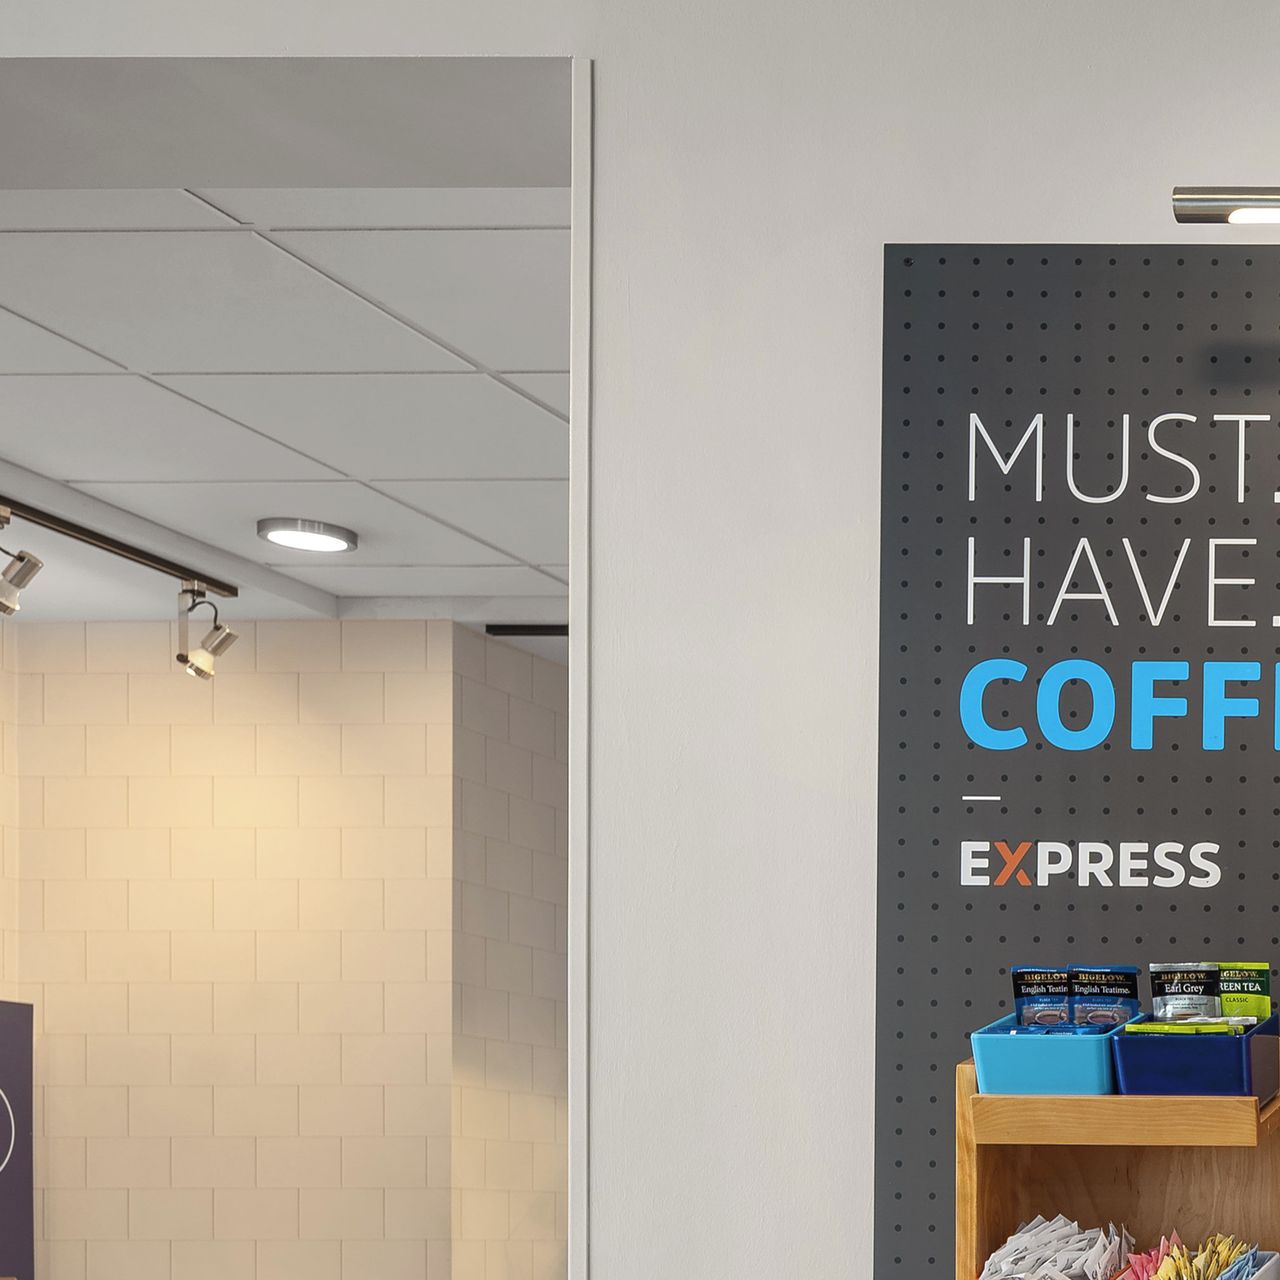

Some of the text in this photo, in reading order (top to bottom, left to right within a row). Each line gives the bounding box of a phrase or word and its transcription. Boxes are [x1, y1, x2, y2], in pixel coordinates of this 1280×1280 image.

[960, 840, 1222, 888] EXPRESS
[1021, 985, 1046, 994] English
[1075, 985, 1100, 994] English
[1165, 984, 1204, 994] Earl Grey
[1242, 982, 1262, 991] TEA
